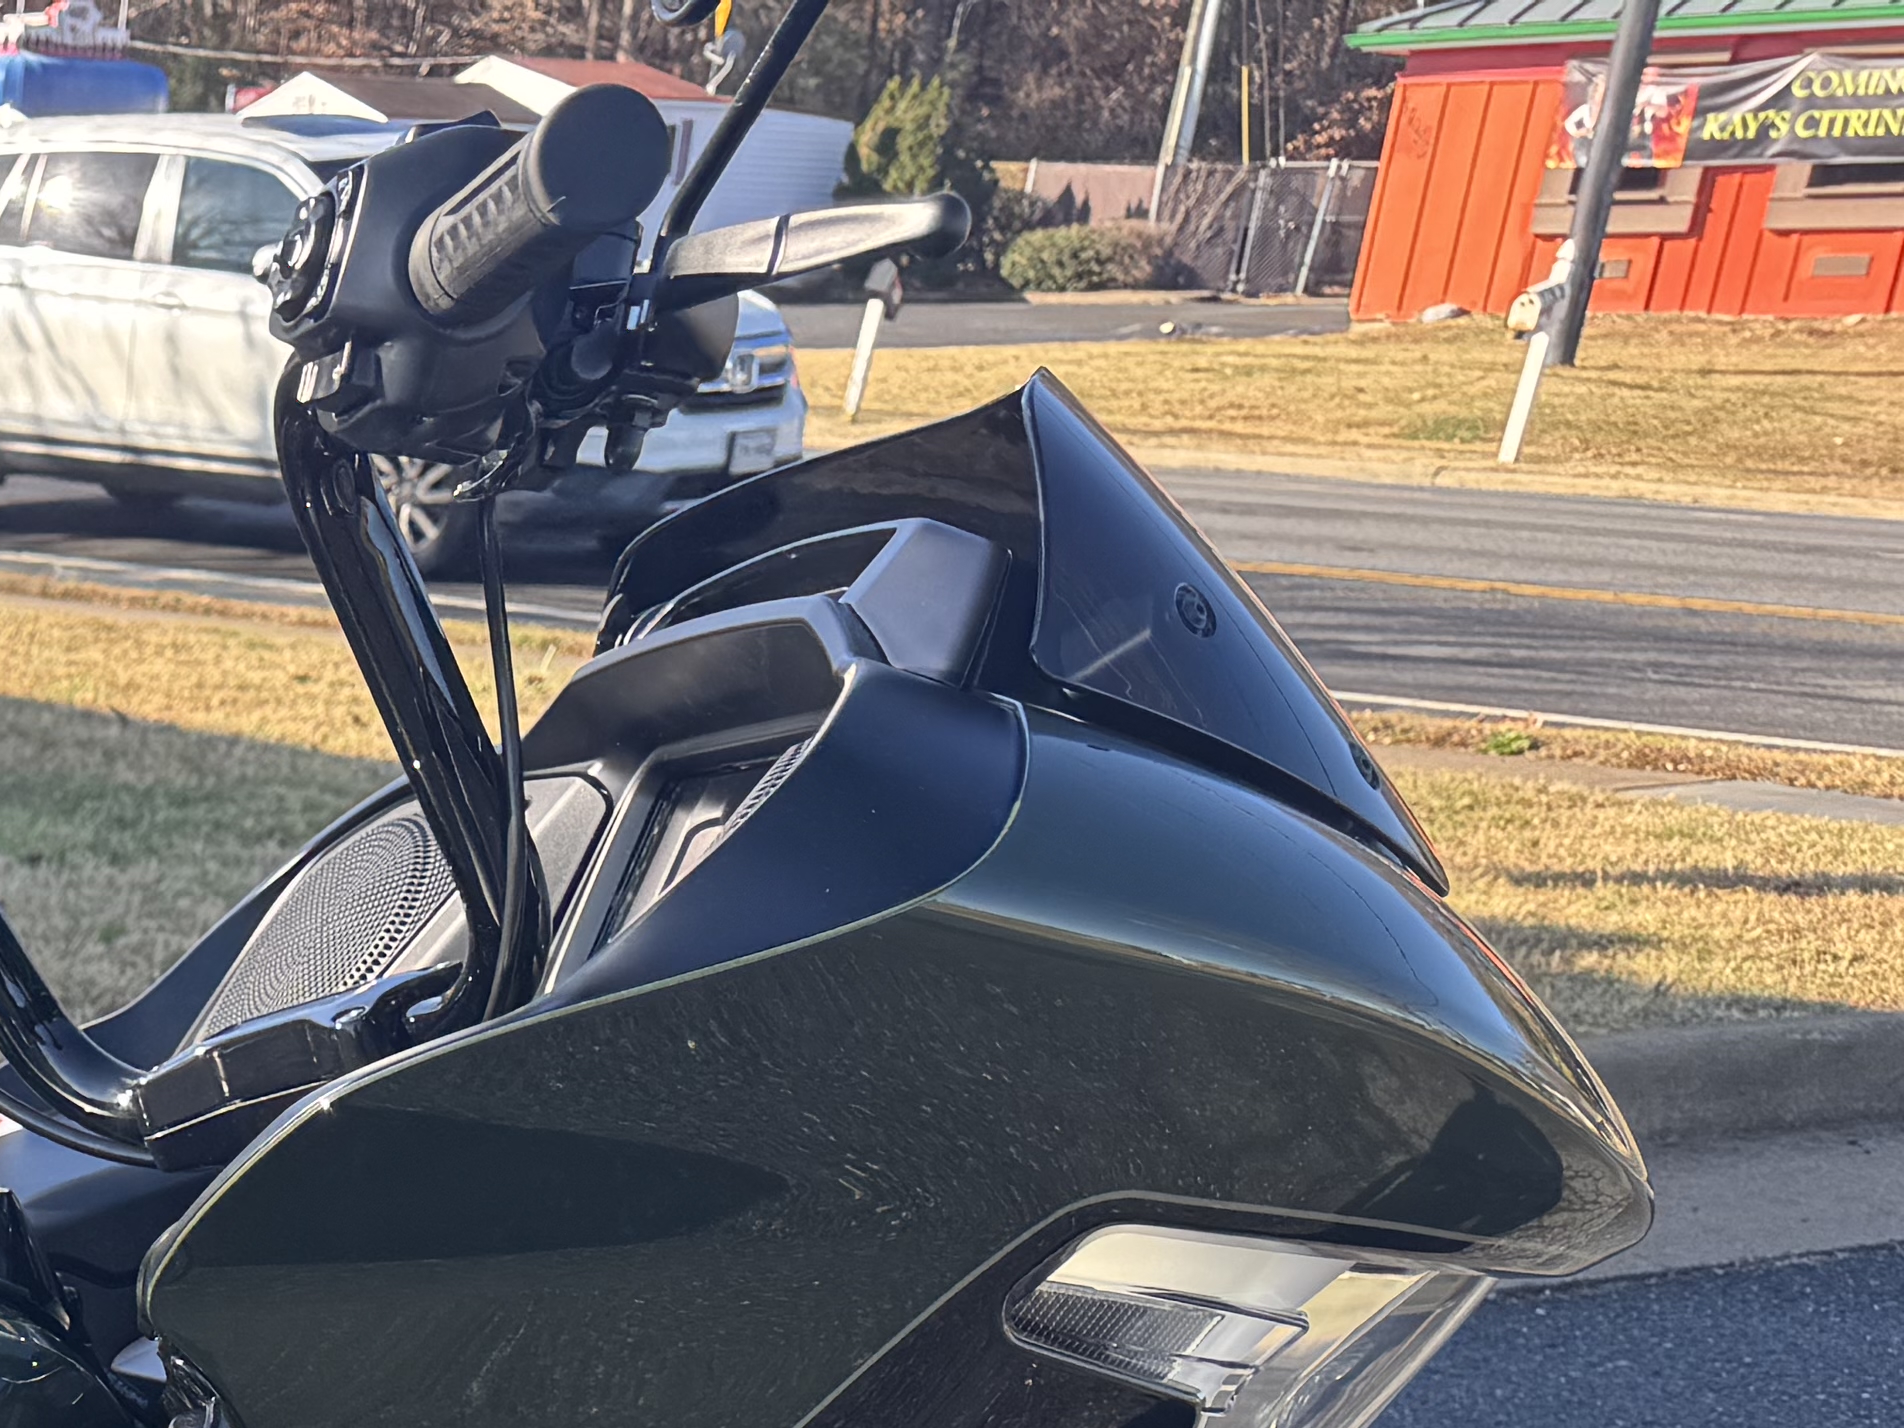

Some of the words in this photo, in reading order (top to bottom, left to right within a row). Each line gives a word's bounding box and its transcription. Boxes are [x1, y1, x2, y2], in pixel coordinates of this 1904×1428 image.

[1791, 69, 1904, 98] COMIN
[1702, 108, 1792, 140] KAY'S
[1794, 108, 1904, 139] CITRIN
